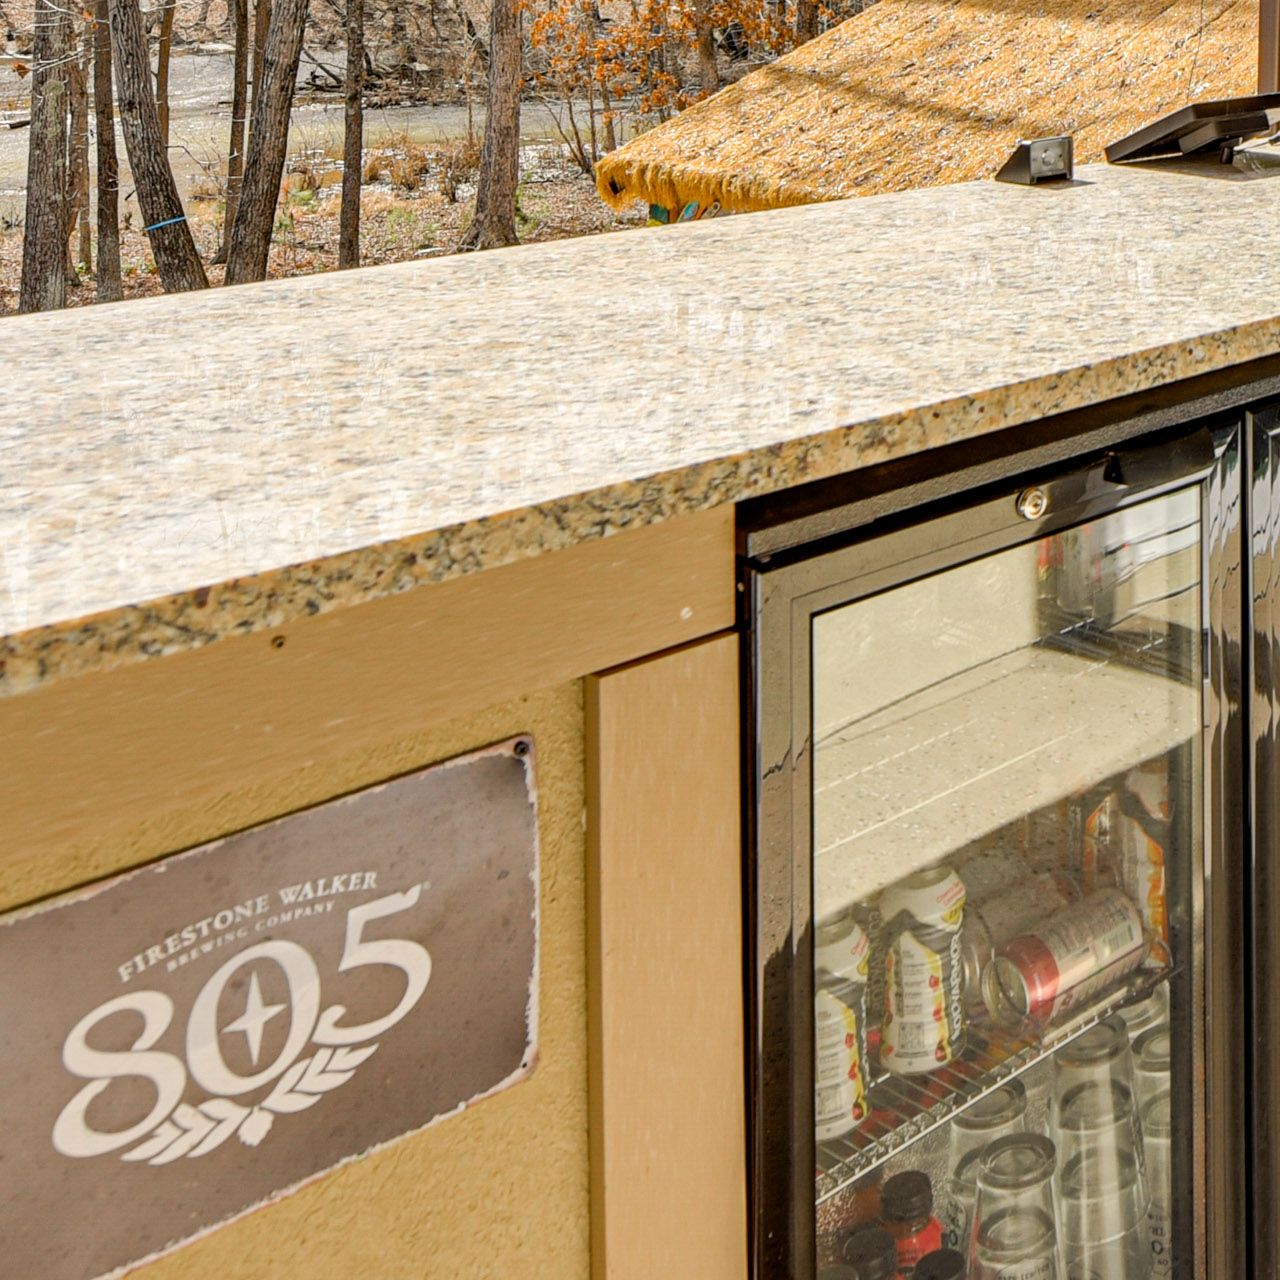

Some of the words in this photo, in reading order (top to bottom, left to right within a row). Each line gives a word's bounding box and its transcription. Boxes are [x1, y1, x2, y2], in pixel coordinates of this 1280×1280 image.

[117, 894, 270, 984] FIRESTONE
[277, 870, 379, 906] WALKER
[166, 927, 249, 973] BREWING
[254, 900, 336, 933] COMPANY
[51, 883, 433, 1158] 805
